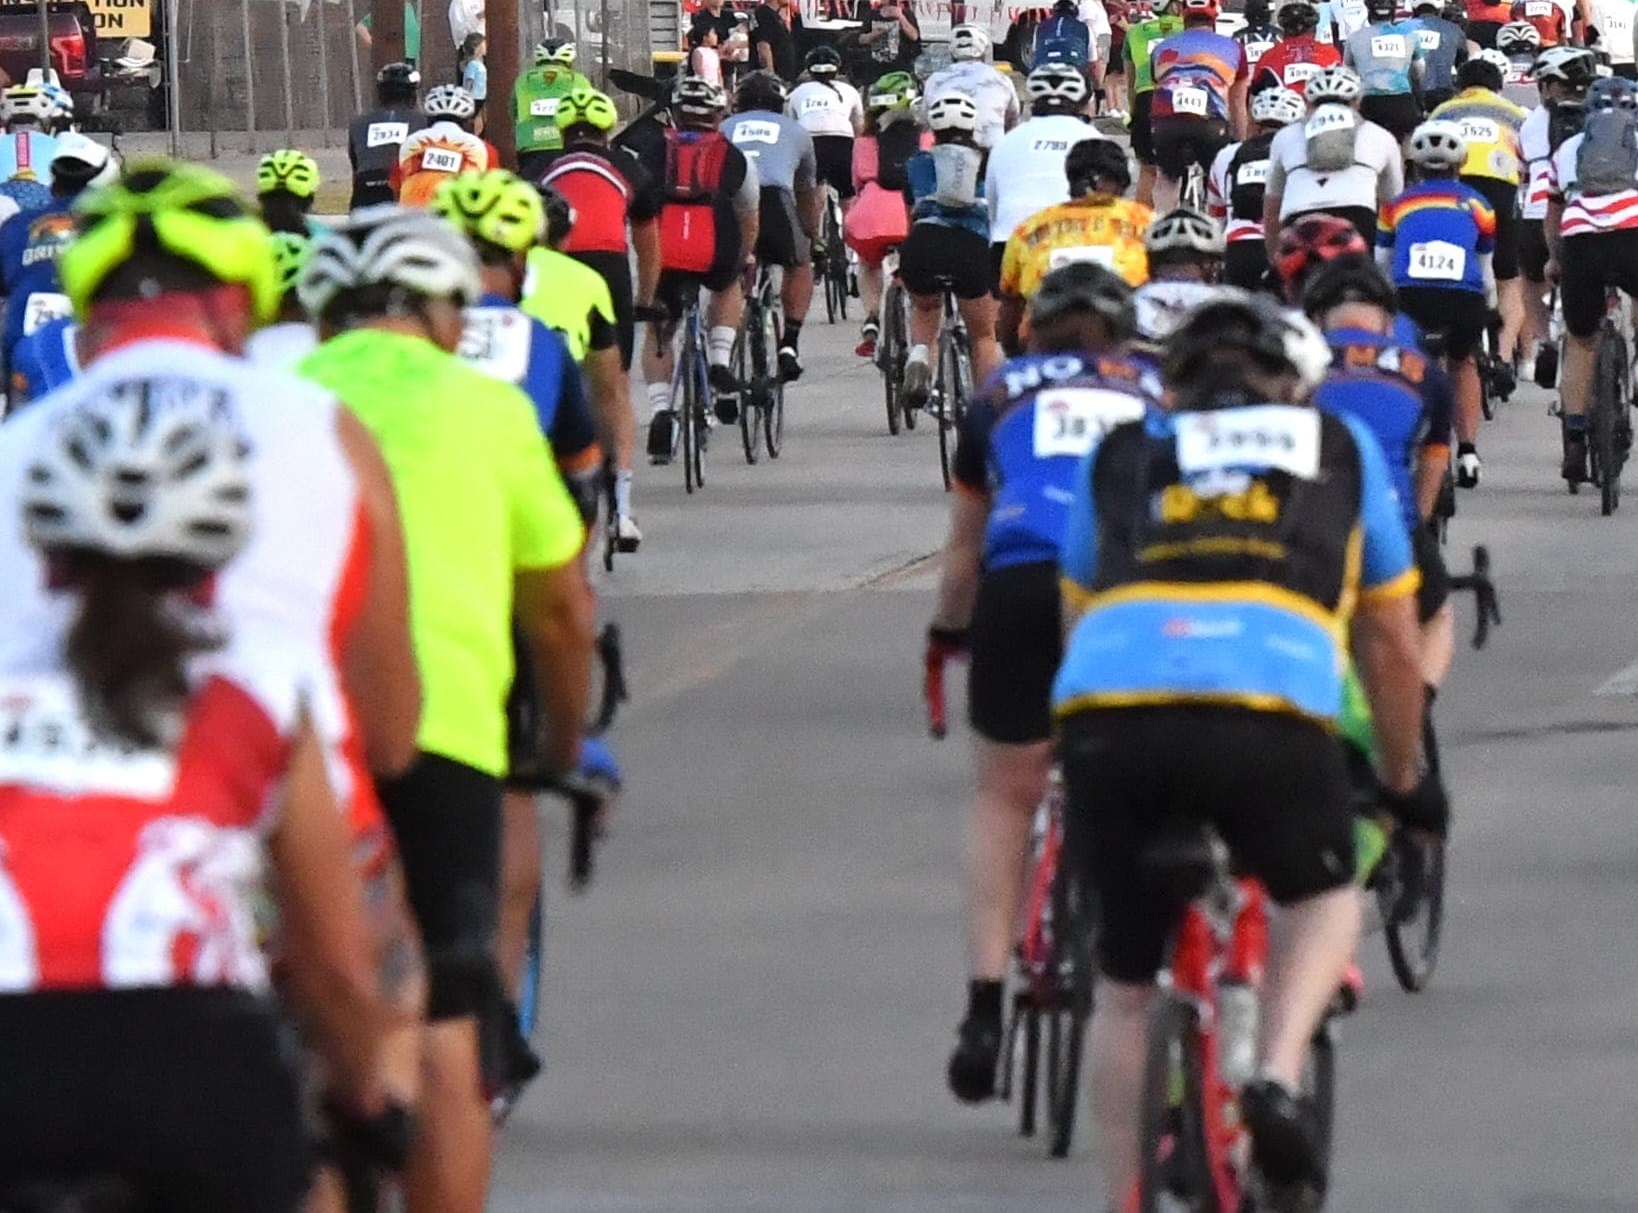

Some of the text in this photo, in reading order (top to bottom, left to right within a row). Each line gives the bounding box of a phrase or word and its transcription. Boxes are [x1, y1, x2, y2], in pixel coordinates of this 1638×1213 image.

[426, 152, 456, 168] 2401
[1418, 254, 1454, 271] 4124
[1005, 355, 1084, 396] NO
